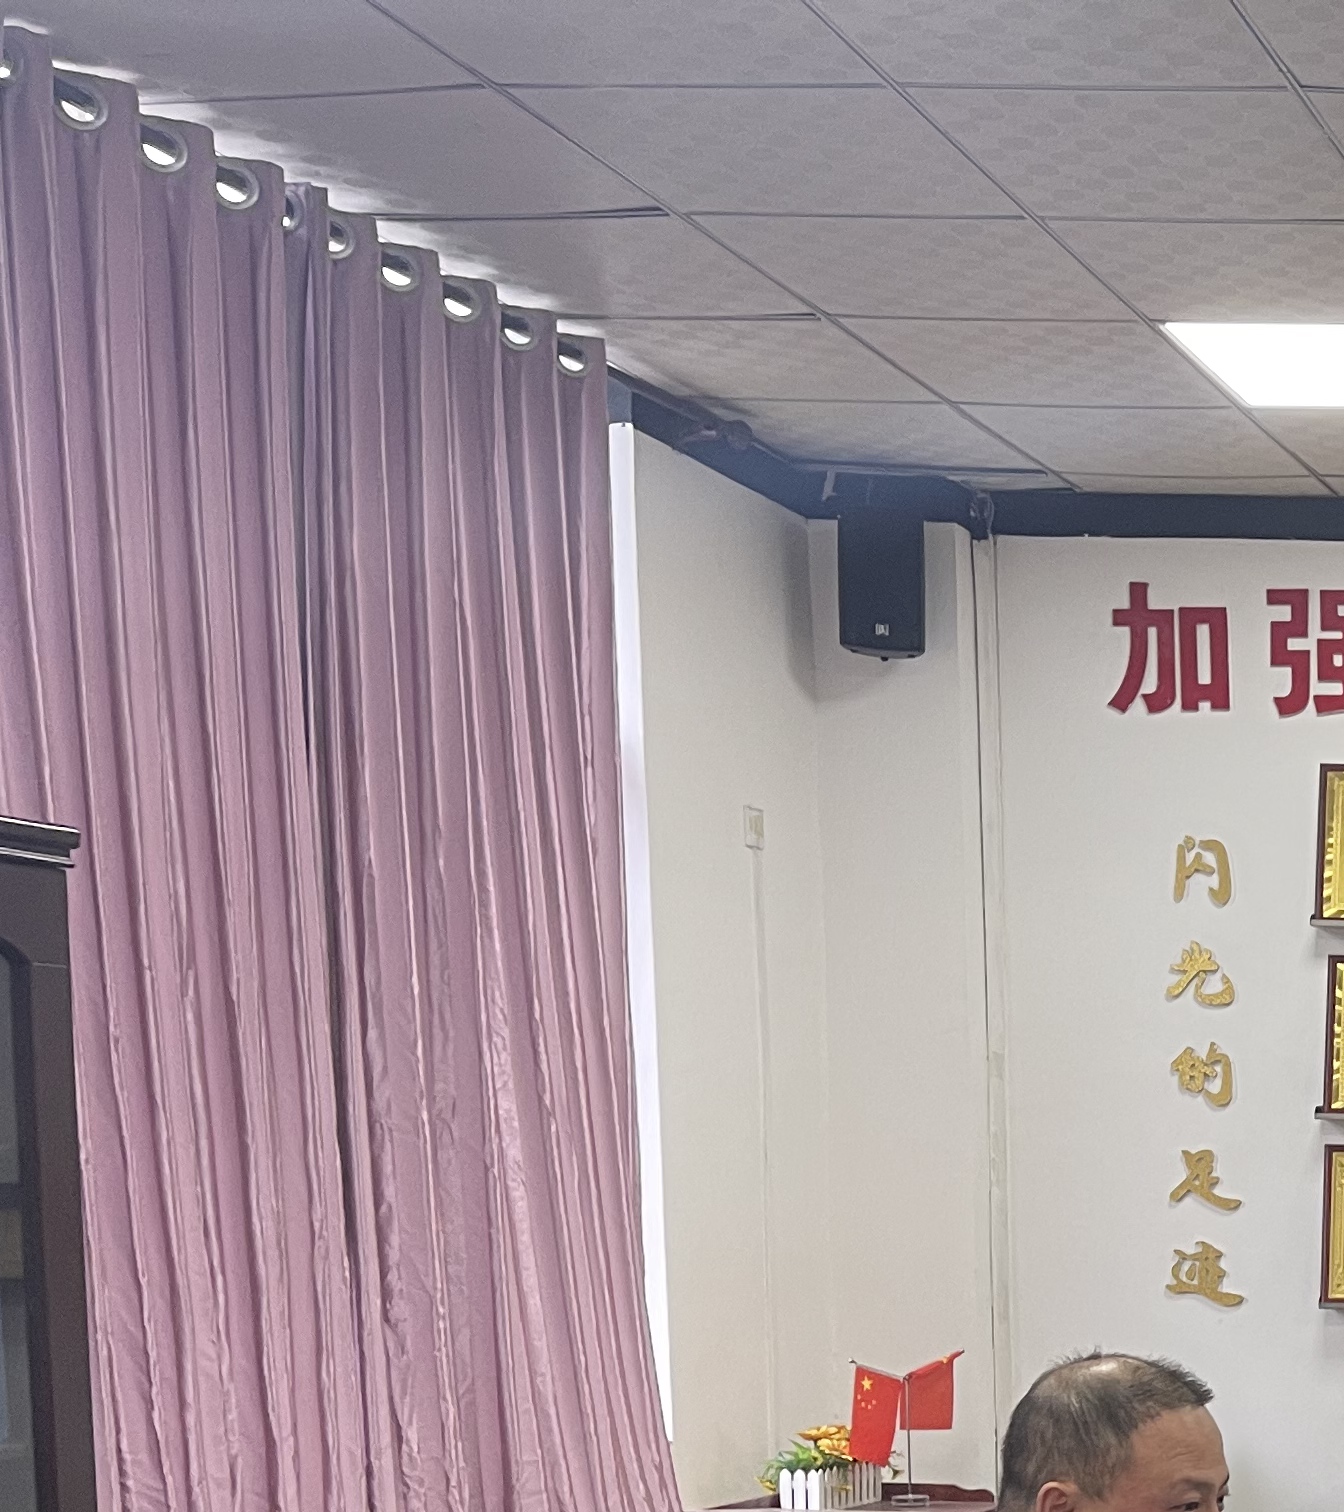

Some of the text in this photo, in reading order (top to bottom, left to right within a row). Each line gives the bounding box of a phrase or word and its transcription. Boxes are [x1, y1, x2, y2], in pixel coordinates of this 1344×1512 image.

[1166, 835, 1245, 1307] 闪光的足迹
